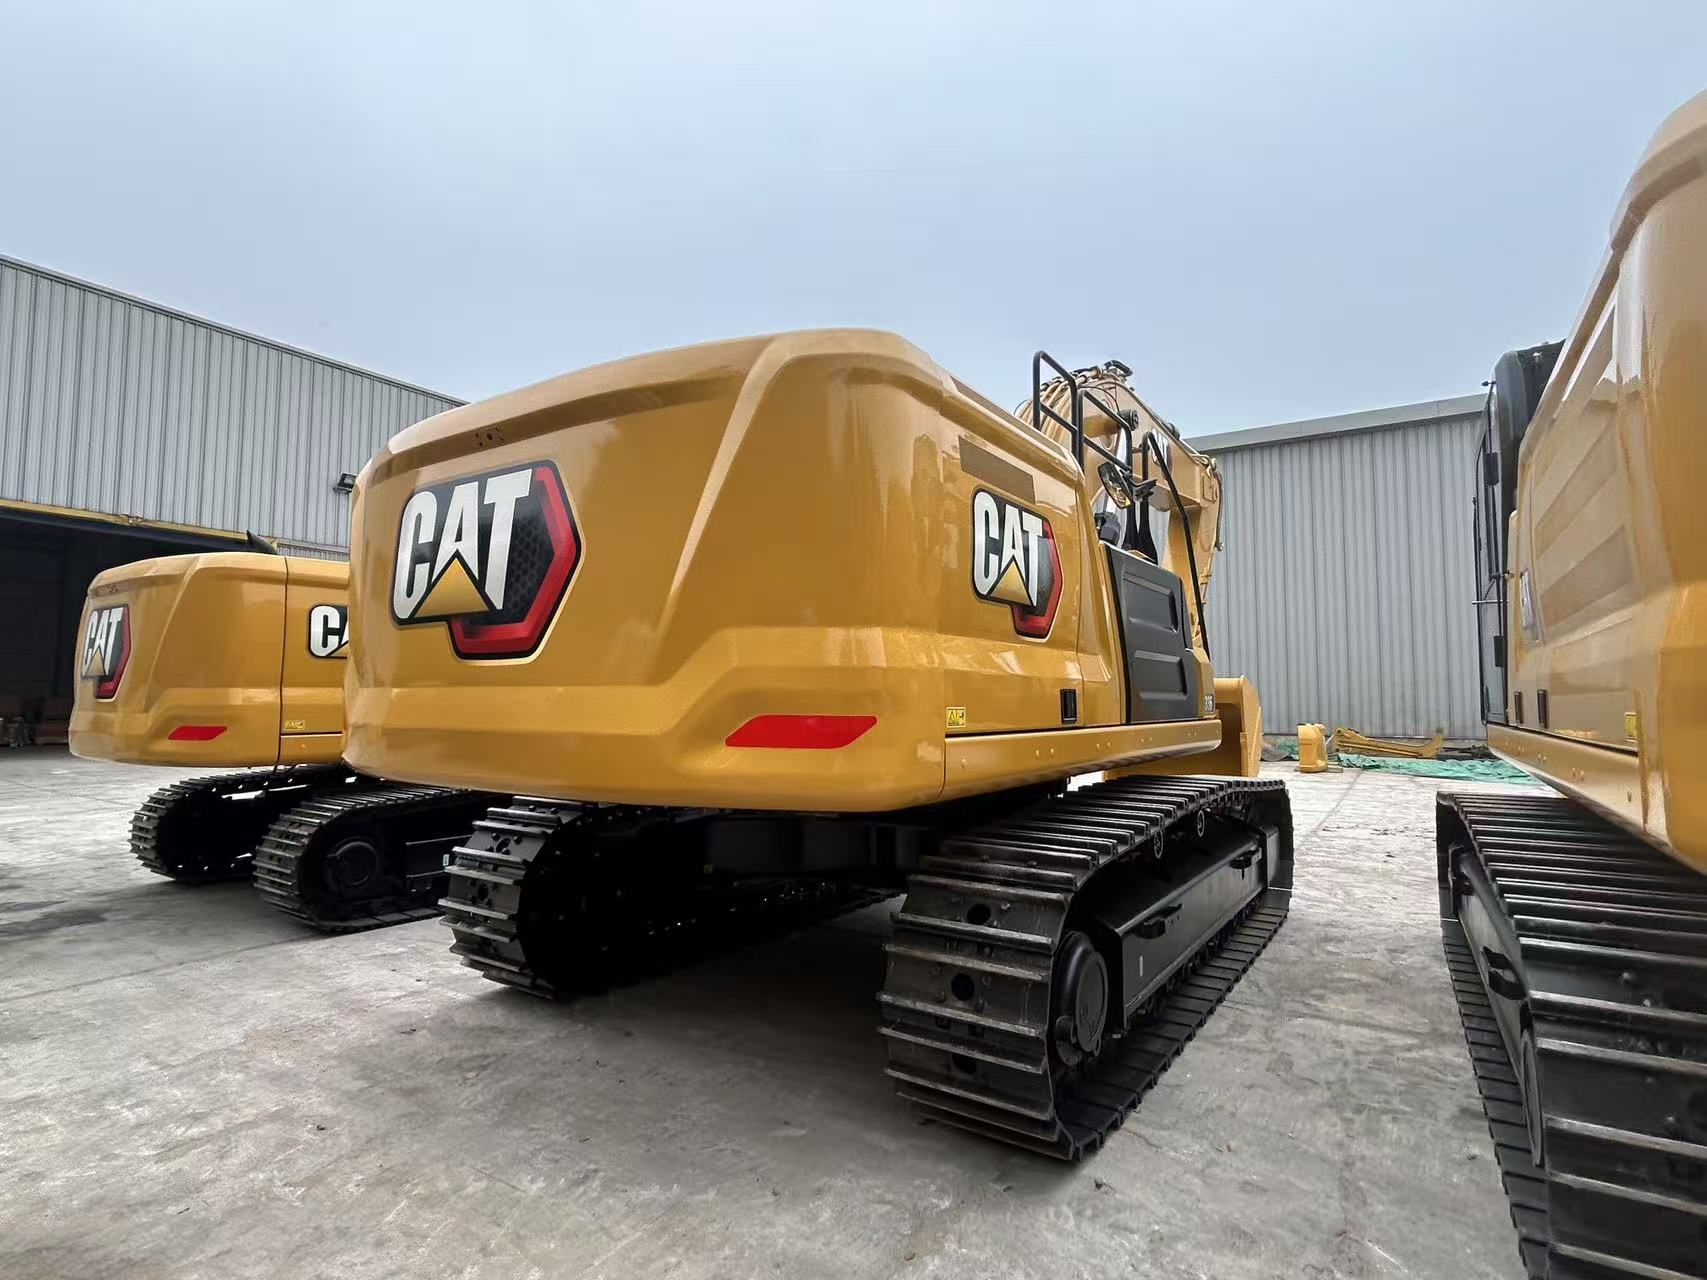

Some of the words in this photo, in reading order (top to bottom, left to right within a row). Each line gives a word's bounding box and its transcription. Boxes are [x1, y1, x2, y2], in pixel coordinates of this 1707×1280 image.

[393, 468, 532, 619] CAT
[974, 491, 1043, 607] CAT
[82, 606, 124, 676] CAT
